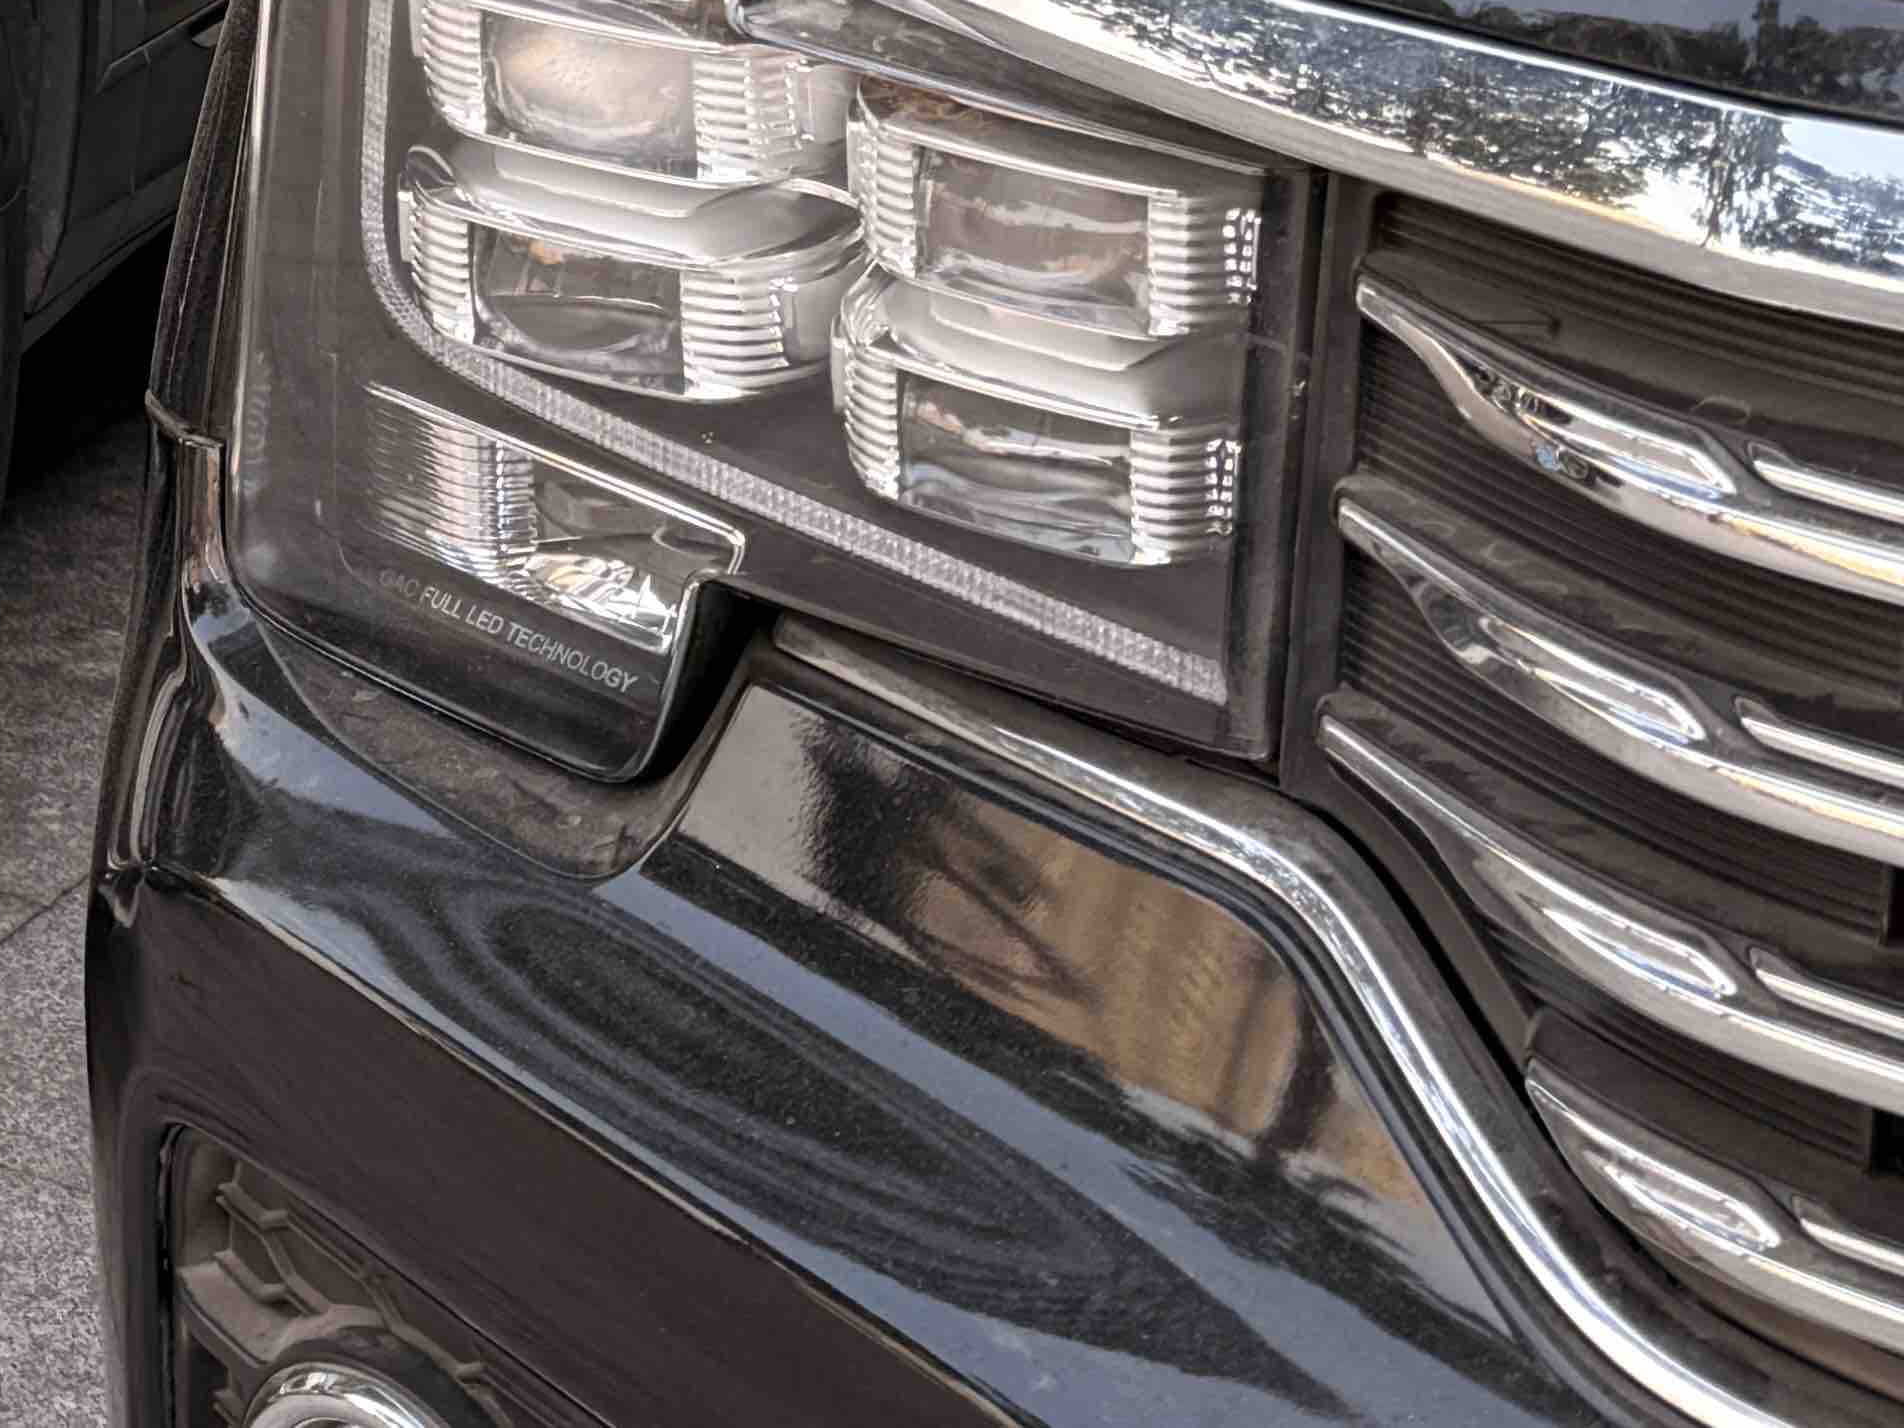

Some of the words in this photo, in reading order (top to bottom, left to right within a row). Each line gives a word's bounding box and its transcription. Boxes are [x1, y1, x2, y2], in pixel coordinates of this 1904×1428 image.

[420, 585, 462, 620] FULL
[464, 604, 505, 635] LED
[506, 620, 641, 694] TECHNOLOGY
